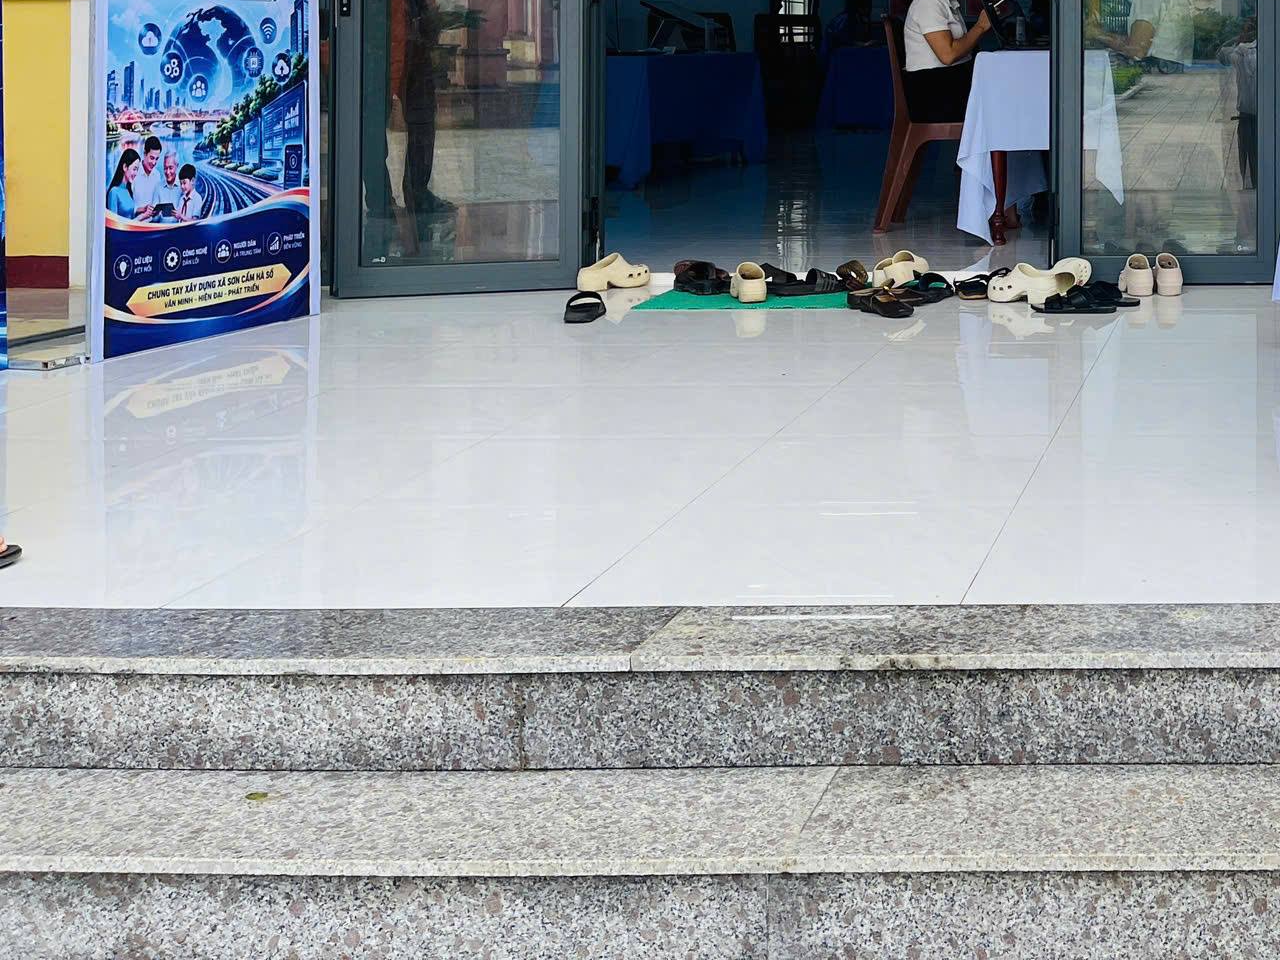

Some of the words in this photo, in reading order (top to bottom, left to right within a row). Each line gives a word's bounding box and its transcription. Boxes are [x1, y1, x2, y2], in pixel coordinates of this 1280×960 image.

[147, 288, 170, 300] CHUNG
[171, 286, 183, 296] TAY
[184, 282, 196, 293] XÂY
[198, 281, 216, 292] DỰNG
[217, 277, 226, 287] XÃ
[227, 276, 240, 286] SƠN
[256, 271, 265, 280] HÀ
[266, 268, 274, 279] SỐ
[177, 297, 193, 306] MINH
[228, 287, 243, 296] PHÁT
